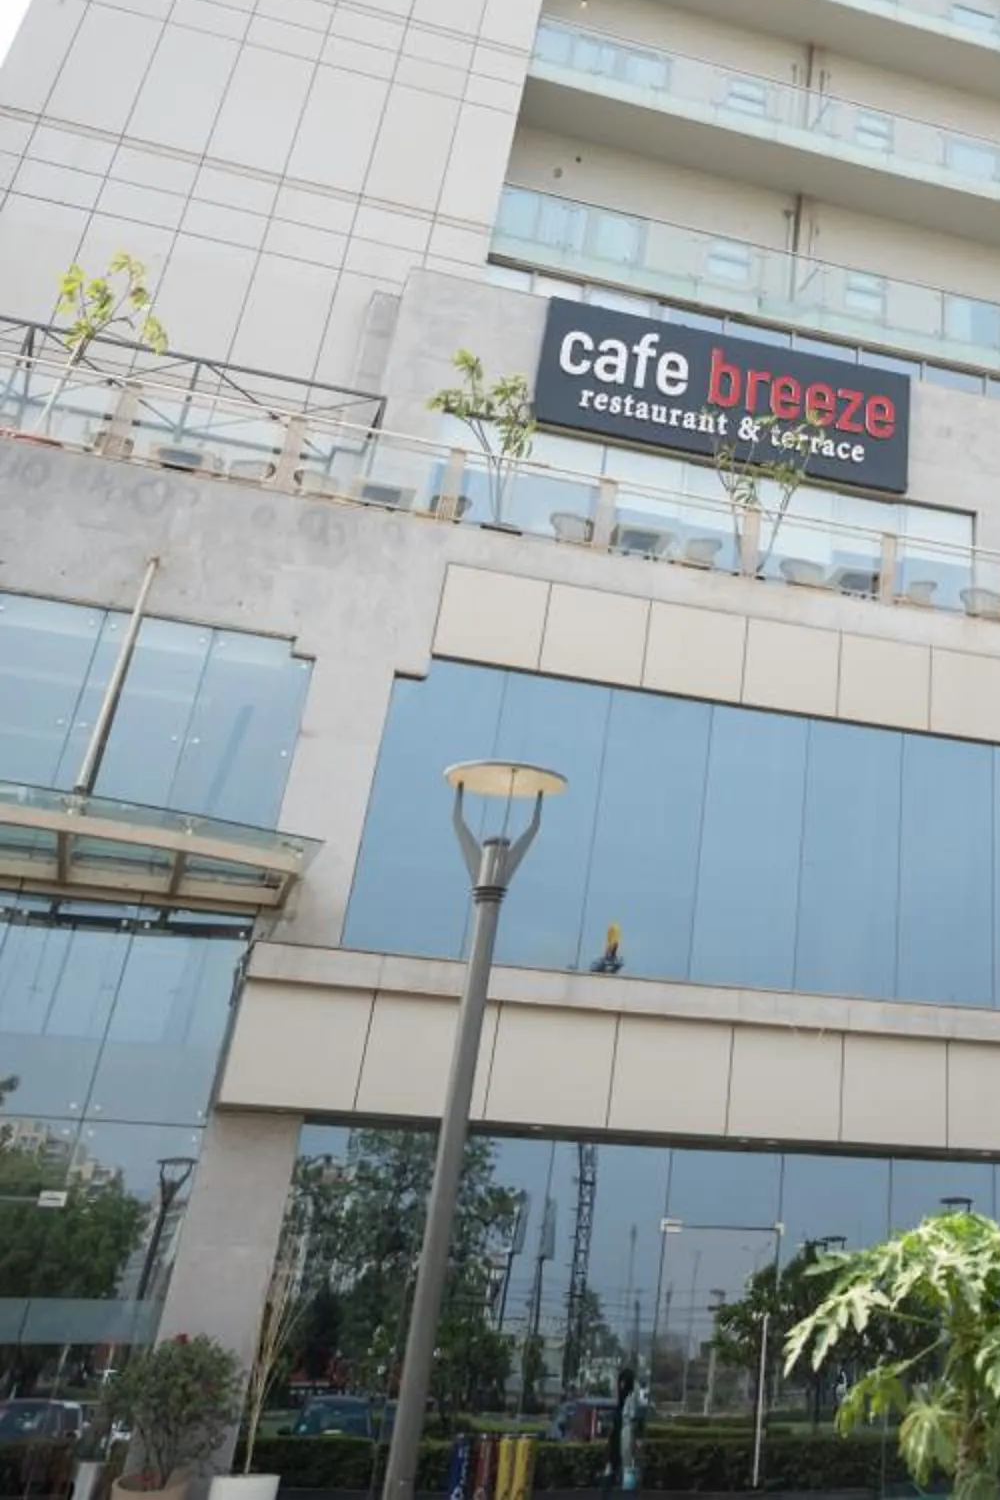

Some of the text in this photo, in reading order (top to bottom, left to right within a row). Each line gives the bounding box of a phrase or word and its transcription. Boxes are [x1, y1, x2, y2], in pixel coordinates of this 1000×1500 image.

[559, 330, 896, 440] cafe breeze
[579, 387, 865, 462] restaurant & terrace
